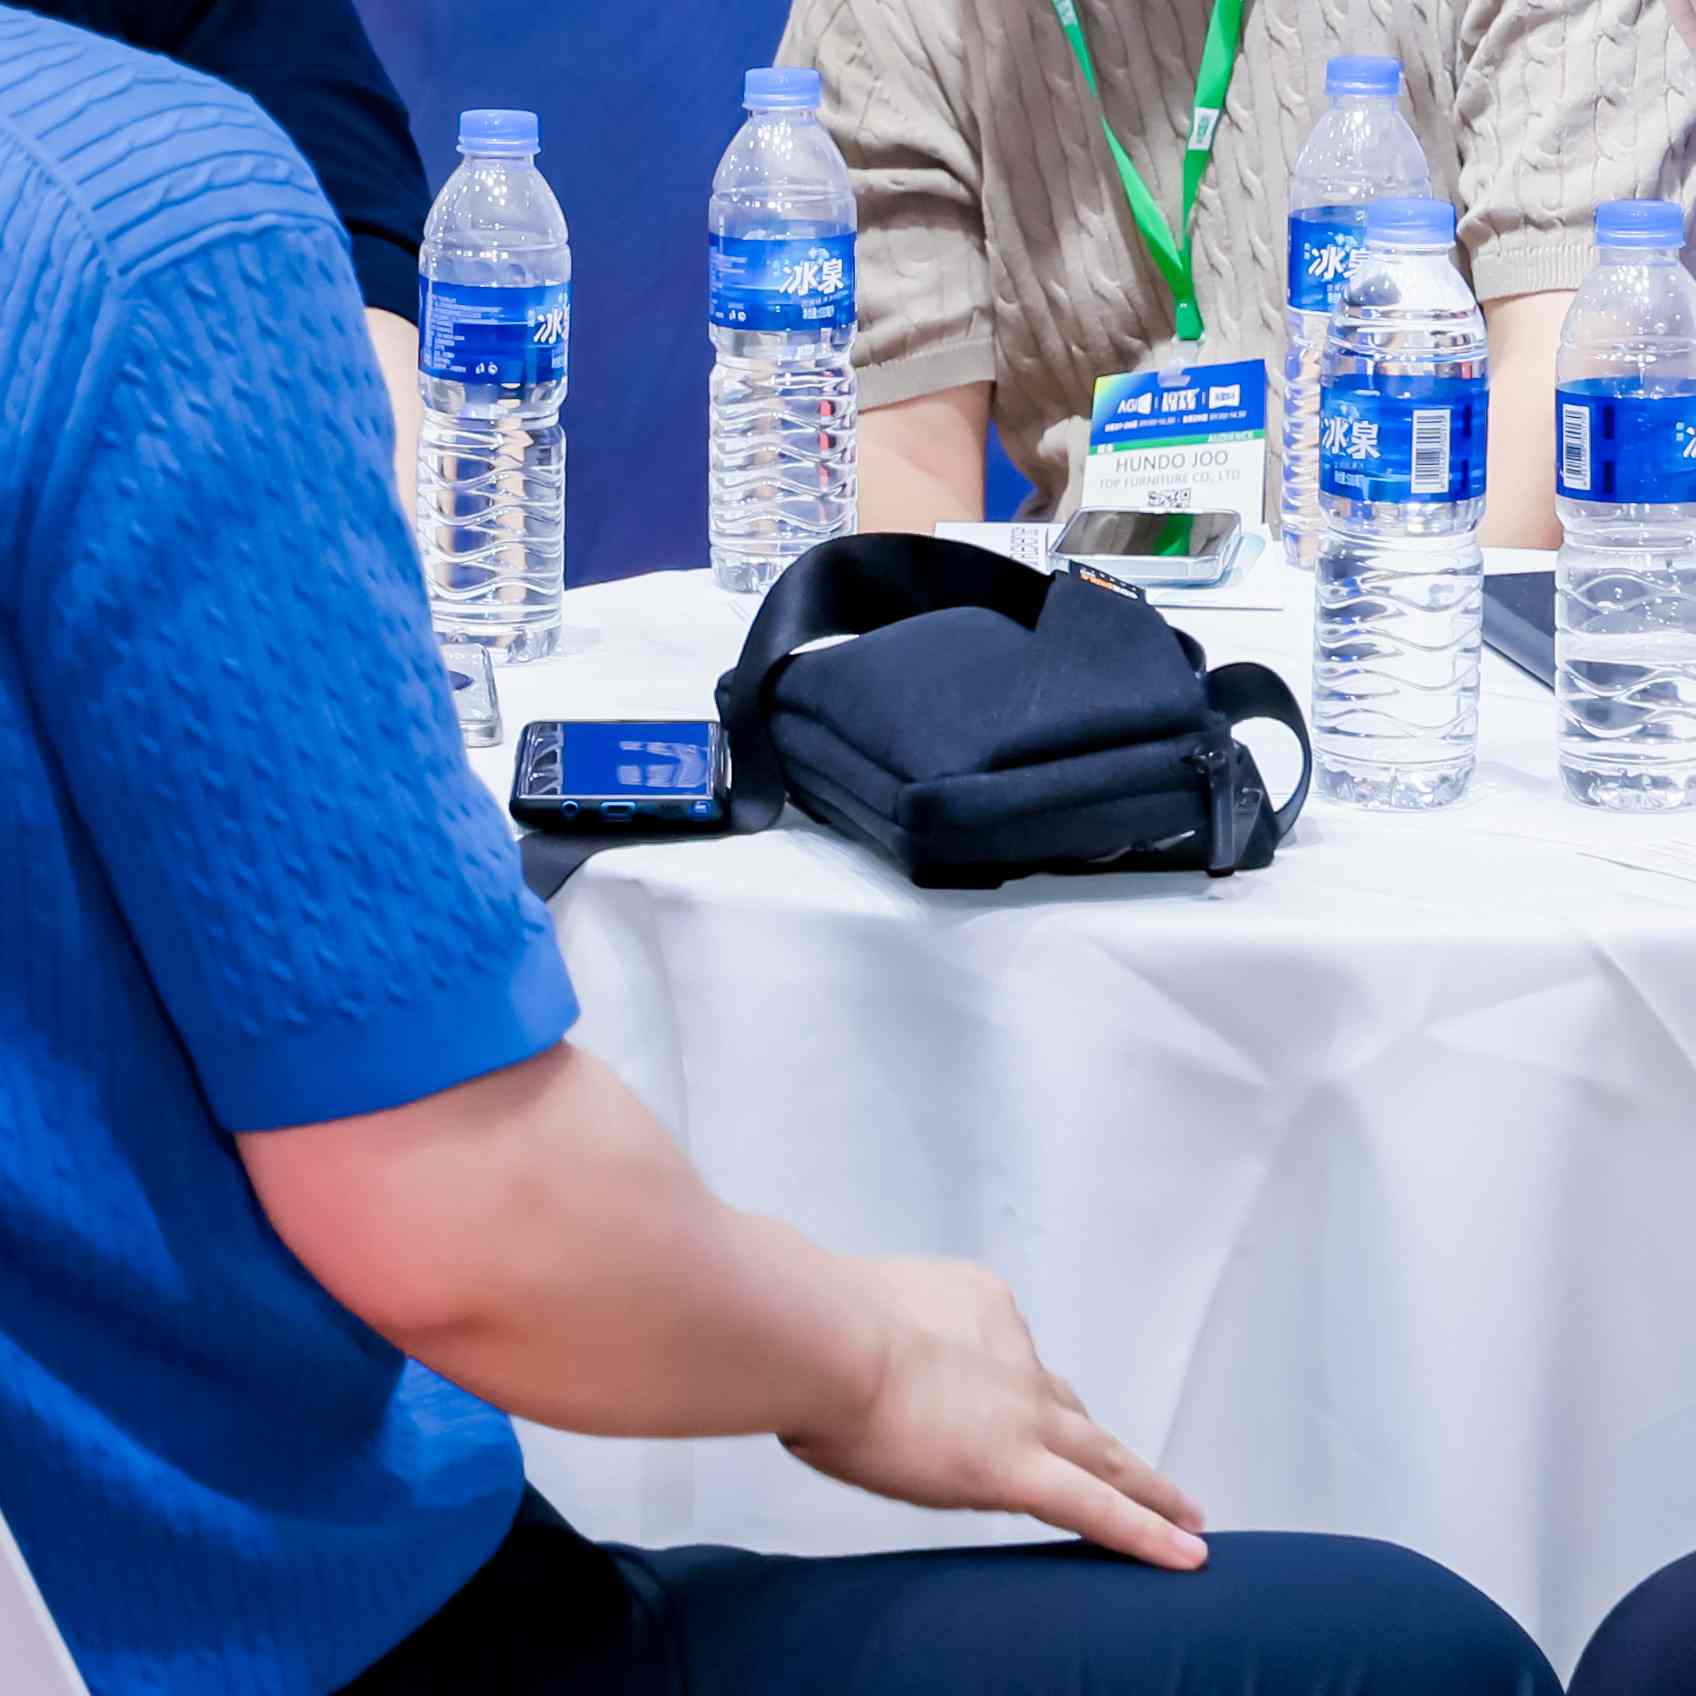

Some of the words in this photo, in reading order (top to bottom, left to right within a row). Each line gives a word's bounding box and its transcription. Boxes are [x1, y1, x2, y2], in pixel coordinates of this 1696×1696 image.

[778, 257, 844, 297] 冰泉
[1321, 416, 1381, 460] 冰泉
[1115, 453, 1186, 473] HUNDO
[1193, 449, 1229, 468] JOO
